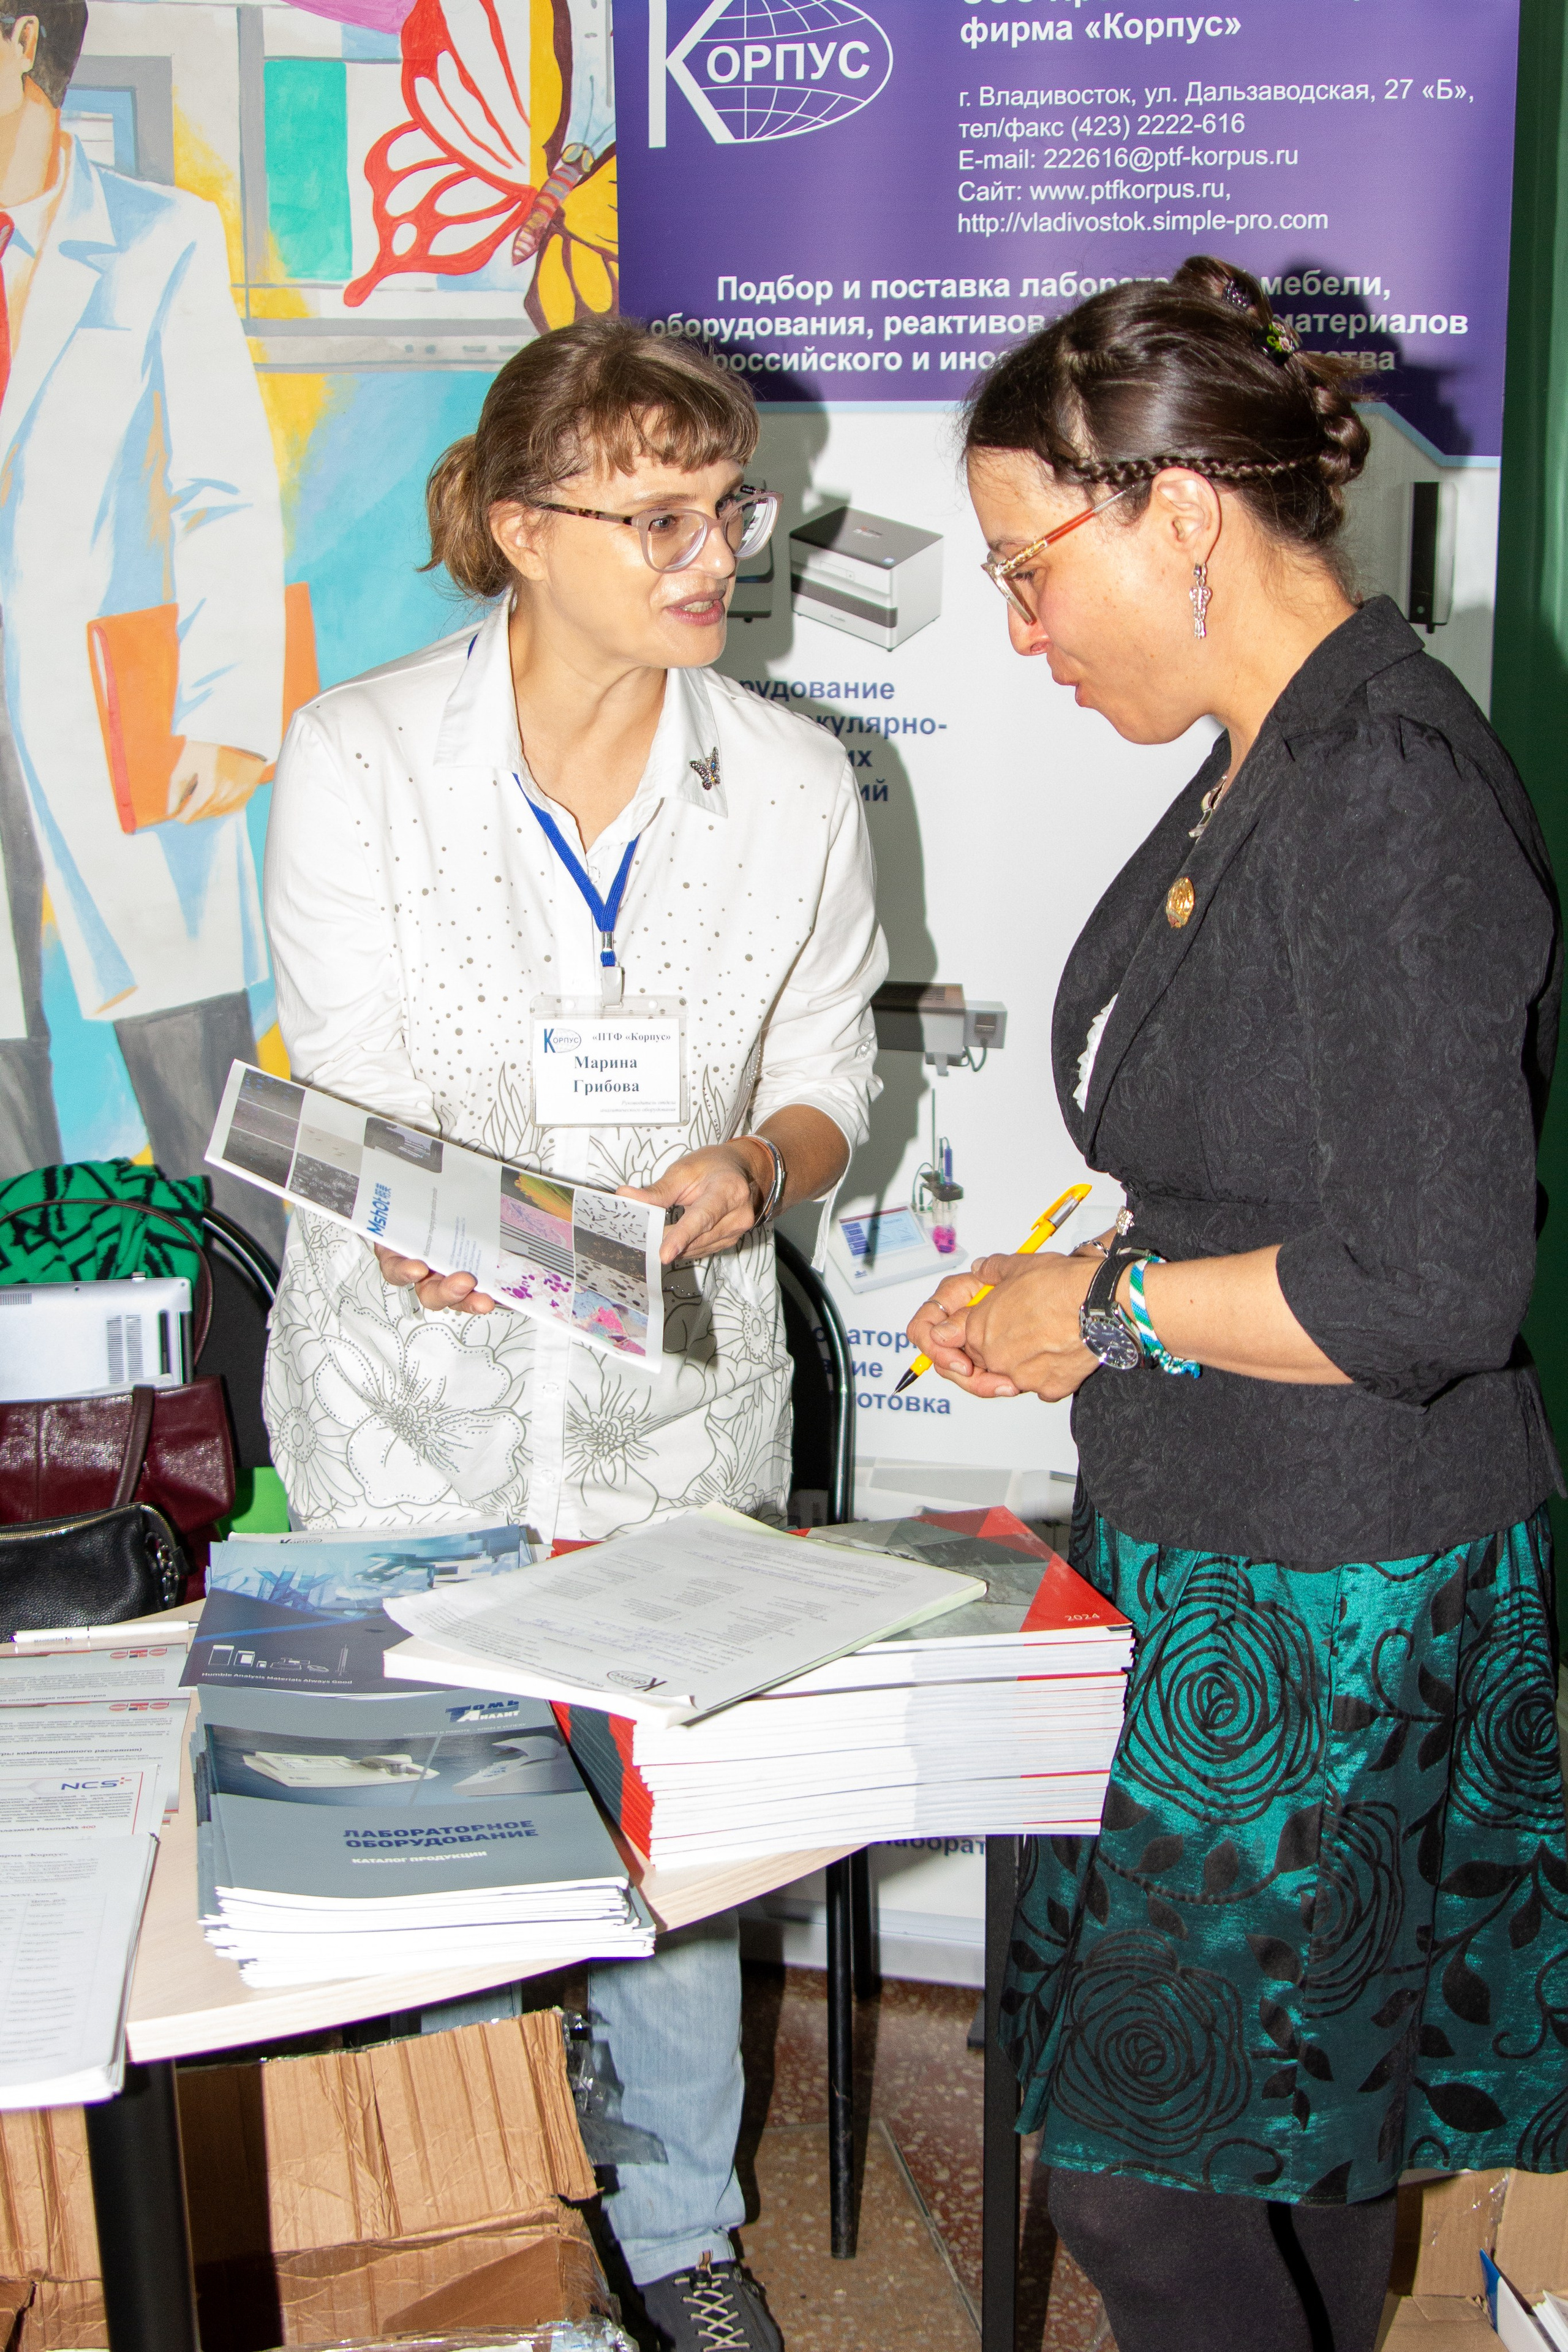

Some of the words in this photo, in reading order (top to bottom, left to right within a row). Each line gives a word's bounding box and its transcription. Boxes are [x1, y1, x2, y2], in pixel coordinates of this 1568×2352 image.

[960, 16, 1072, 49] фирма
[1085, 11, 1241, 45] «Корпус»
[960, 91, 971, 107] г.
[980, 86, 1136, 108] Владивосток,
[1145, 86, 1177, 108] ул.
[1185, 81, 1376, 106] Дальзаводская,
[1384, 79, 1414, 99] 27
[1422, 78, 1474, 103] «Б»,
[959, 118, 1064, 141] тел/факс
[1071, 115, 1130, 141] (423)
[1137, 113, 1245, 135] 2222-616
[959, 149, 1036, 170] E-mail:
[1044, 146, 1298, 172] 222616@ptf-korpus.ru
[959, 181, 1022, 201] Сайт:
[1030, 178, 1231, 204] www.ptfkorpus.ru,
[958, 209, 1328, 237] http://vladivostok.simple-pro.com
[717, 275, 833, 305] Подбор
[843, 280, 860, 298] и
[872, 277, 1011, 300] поставка
[1261, 270, 1390, 300] мебели,
[650, 312, 874, 342] оборудования,
[884, 312, 1044, 341] реактивов
[713, 346, 903, 372] российского
[913, 352, 930, 370] и
[739, 680, 895, 701] рудование
[807, 714, 947, 739] кулярно-
[625, 1033, 671, 1042] «Корпус»
[574, 1056, 638, 1072] Марина
[573, 1079, 639, 1096] Грибова
[857, 1392, 951, 1414] отовка
[1065, 1613, 1100, 1621] 2024
[61, 1779, 119, 1790] NCS
[343, 1820, 535, 1838] ЛАБОРАТОРНОЕ
[345, 1829, 539, 1848] ОБОРУДОВАНИЕ
[410, 1851, 488, 1862] ПРОДУКЦИИ
